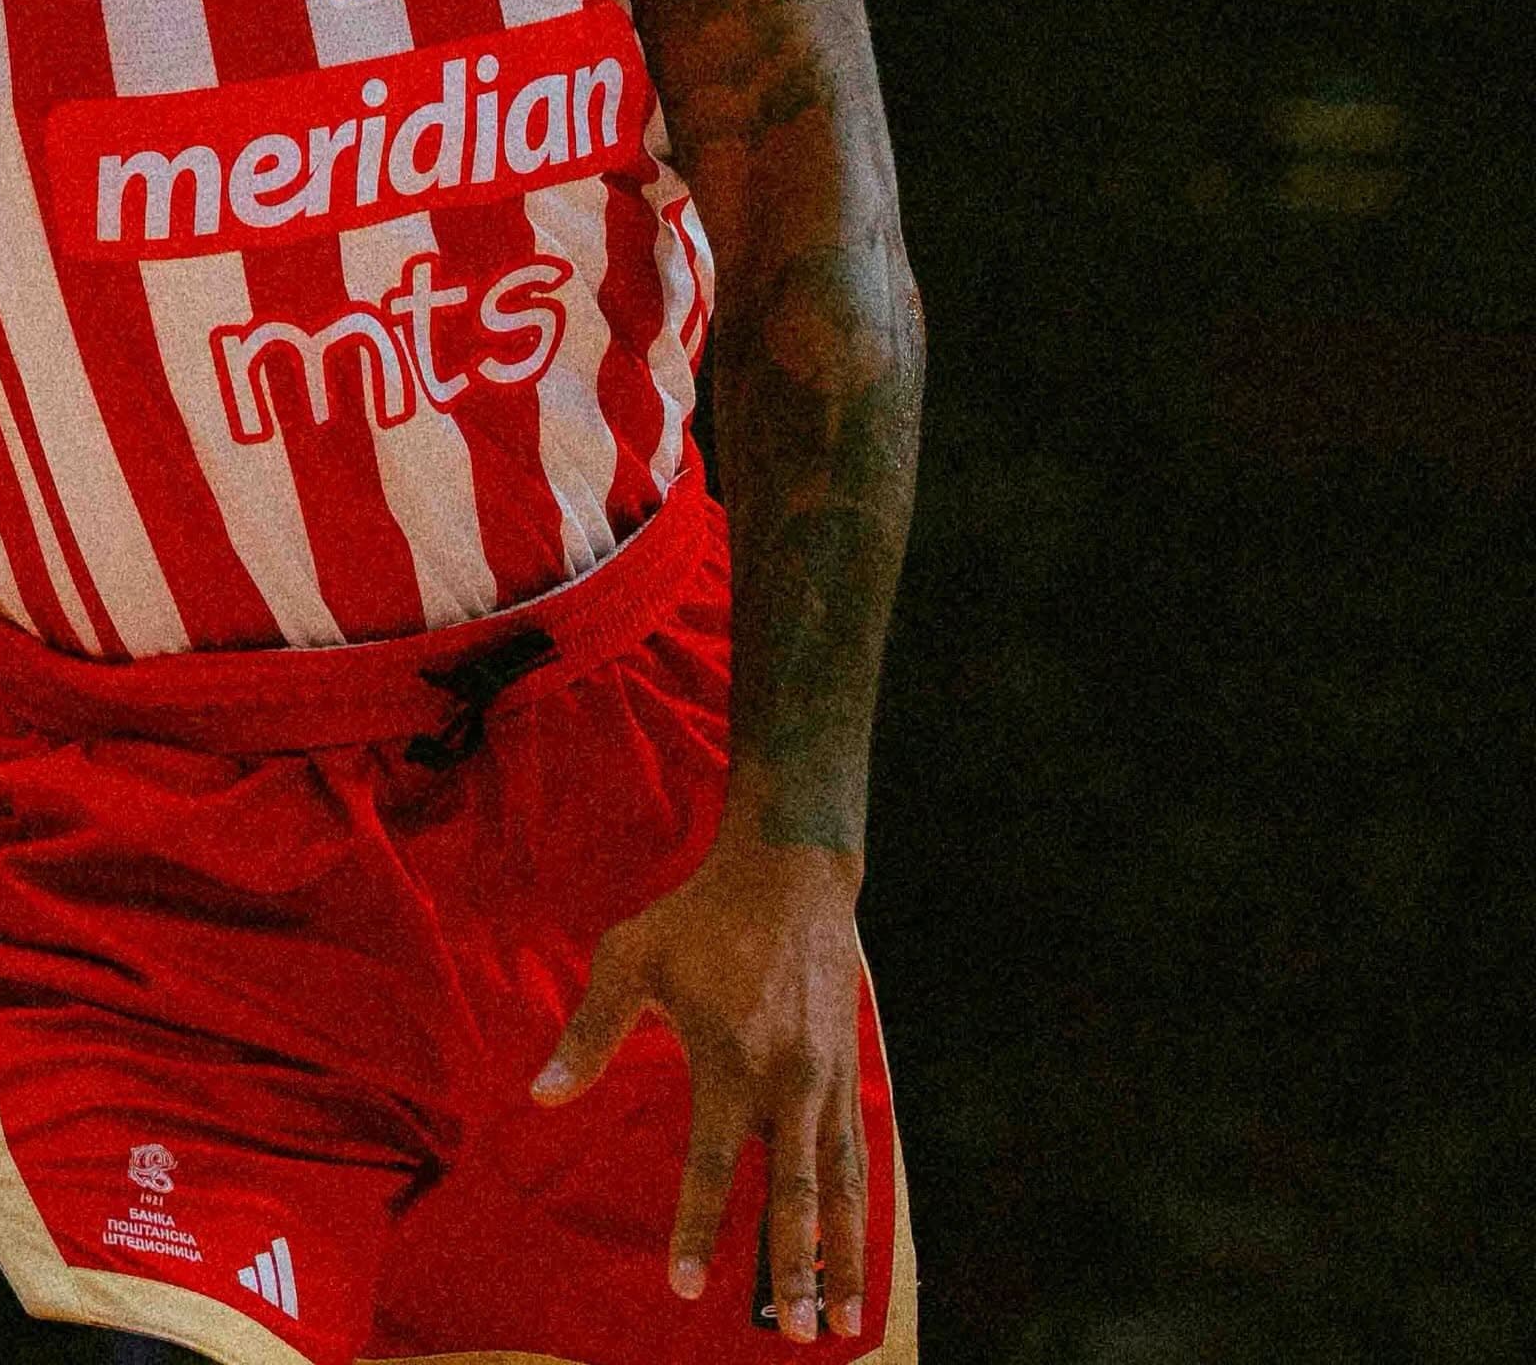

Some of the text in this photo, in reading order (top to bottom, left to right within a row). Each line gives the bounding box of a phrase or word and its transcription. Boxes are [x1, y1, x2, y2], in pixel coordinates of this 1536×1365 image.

[96, 53, 625, 242] meridian
[216, 259, 568, 439] mts
[139, 1192, 164, 1207] 1921
[107, 1218, 197, 1246] ПОШТАНСКА
[129, 1207, 176, 1228] БАНКА
[102, 1232, 203, 1262] ШТЕДИОНИЦА
